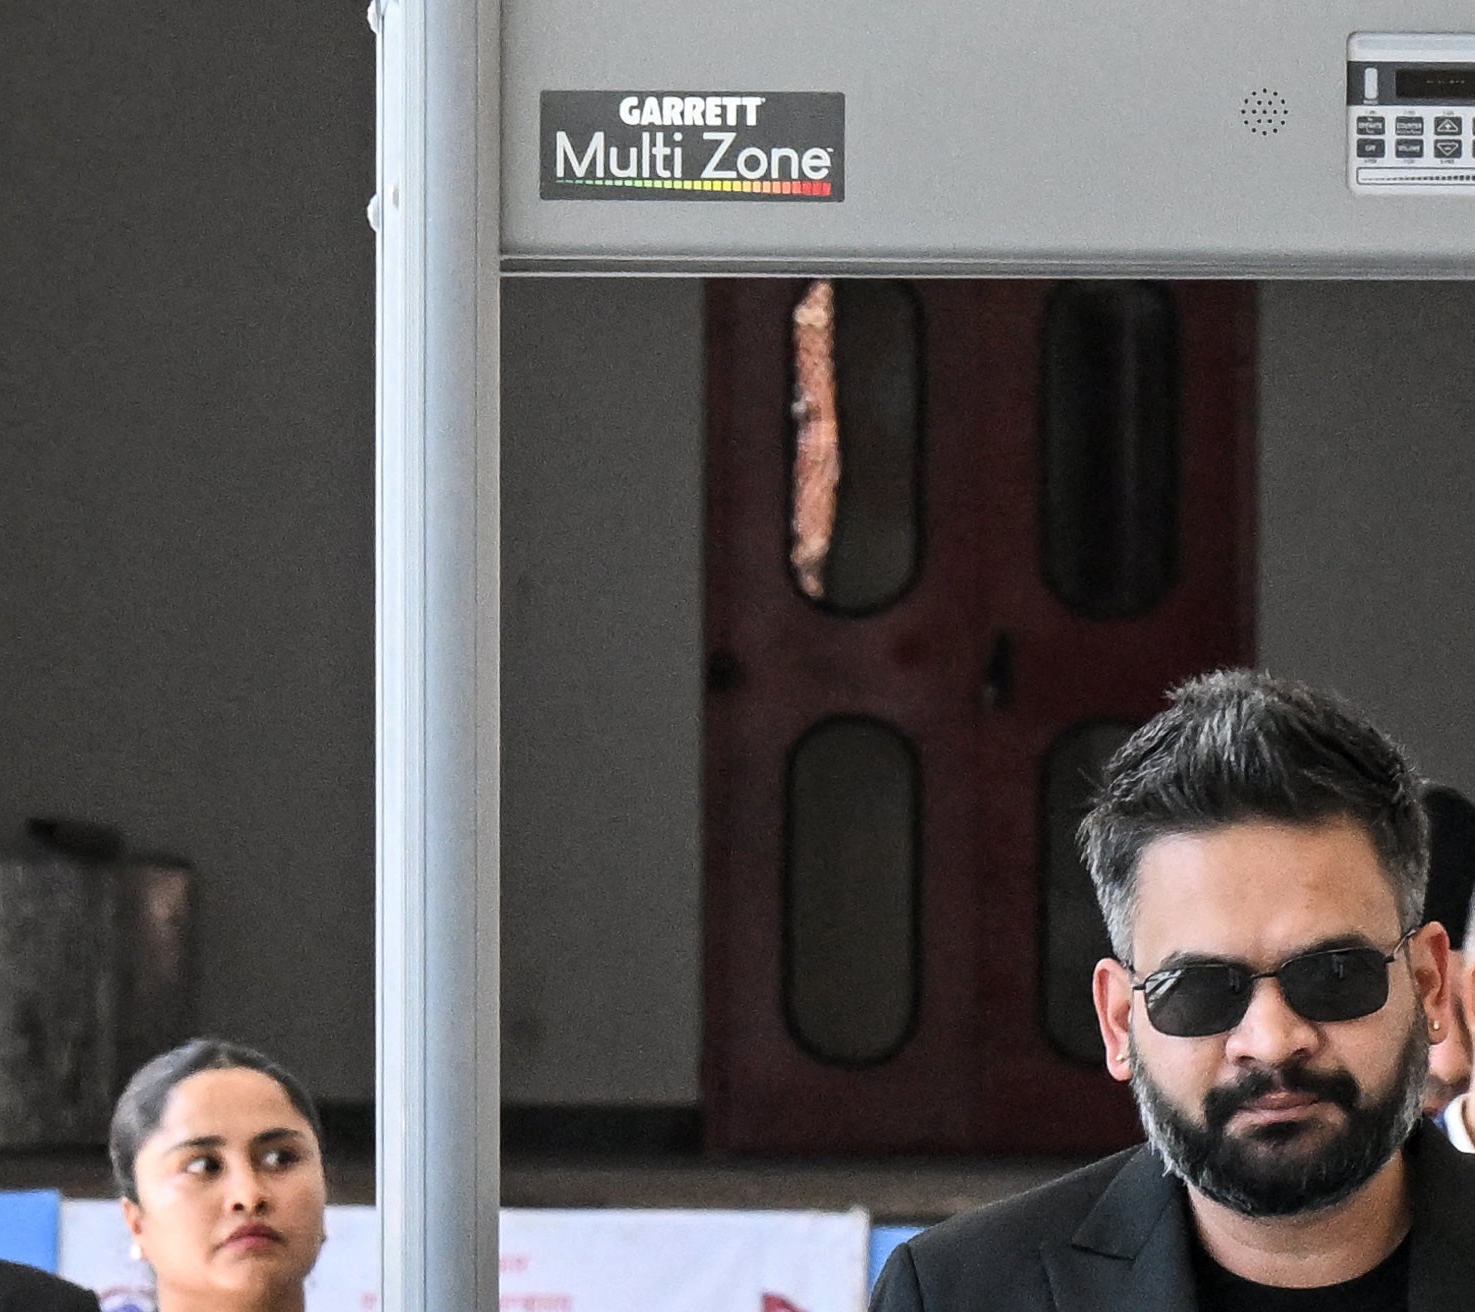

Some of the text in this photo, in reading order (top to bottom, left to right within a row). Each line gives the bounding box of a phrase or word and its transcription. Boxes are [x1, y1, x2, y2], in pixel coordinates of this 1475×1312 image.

[619, 96, 762, 126] GARRETT
[556, 131, 832, 179] Multi Zone
